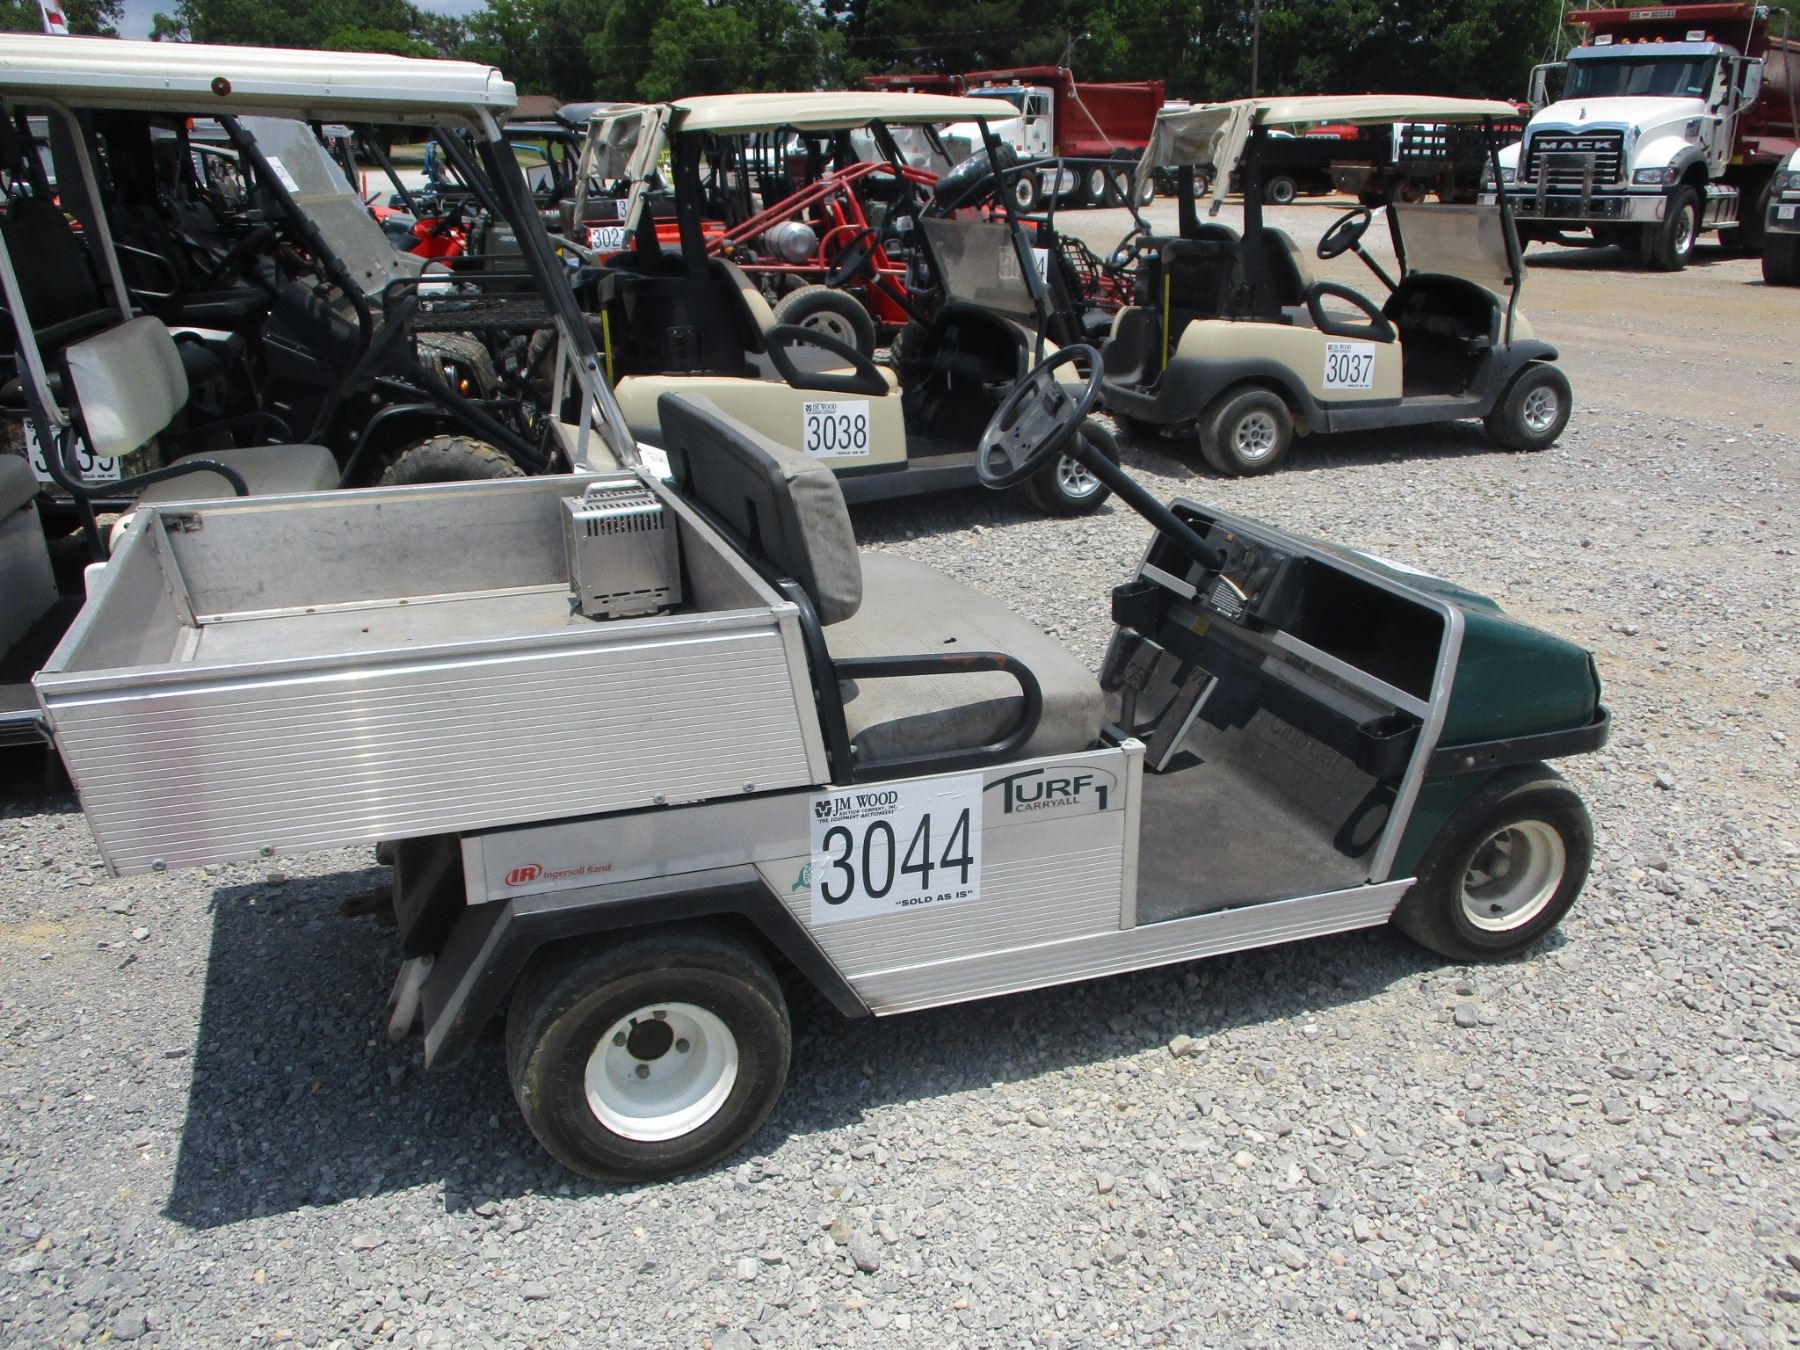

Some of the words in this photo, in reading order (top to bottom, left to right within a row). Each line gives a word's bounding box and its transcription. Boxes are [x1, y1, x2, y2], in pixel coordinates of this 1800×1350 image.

[1539, 141, 1612, 149] MACK
[593, 229, 625, 248] 302
[1327, 353, 1373, 382] 3037
[807, 414, 866, 451] 3038
[983, 768, 1094, 814] TURF
[1095, 785, 1108, 810] 1
[833, 796, 851, 817] JM
[856, 790, 898, 808] WOOD
[1015, 796, 1080, 813] CARRYALL
[820, 808, 974, 906] 3044
[509, 866, 538, 884] IR
[543, 867, 585, 880] Ingersoll
[587, 863, 612, 874] Rand
[937, 893, 952, 902] AS
